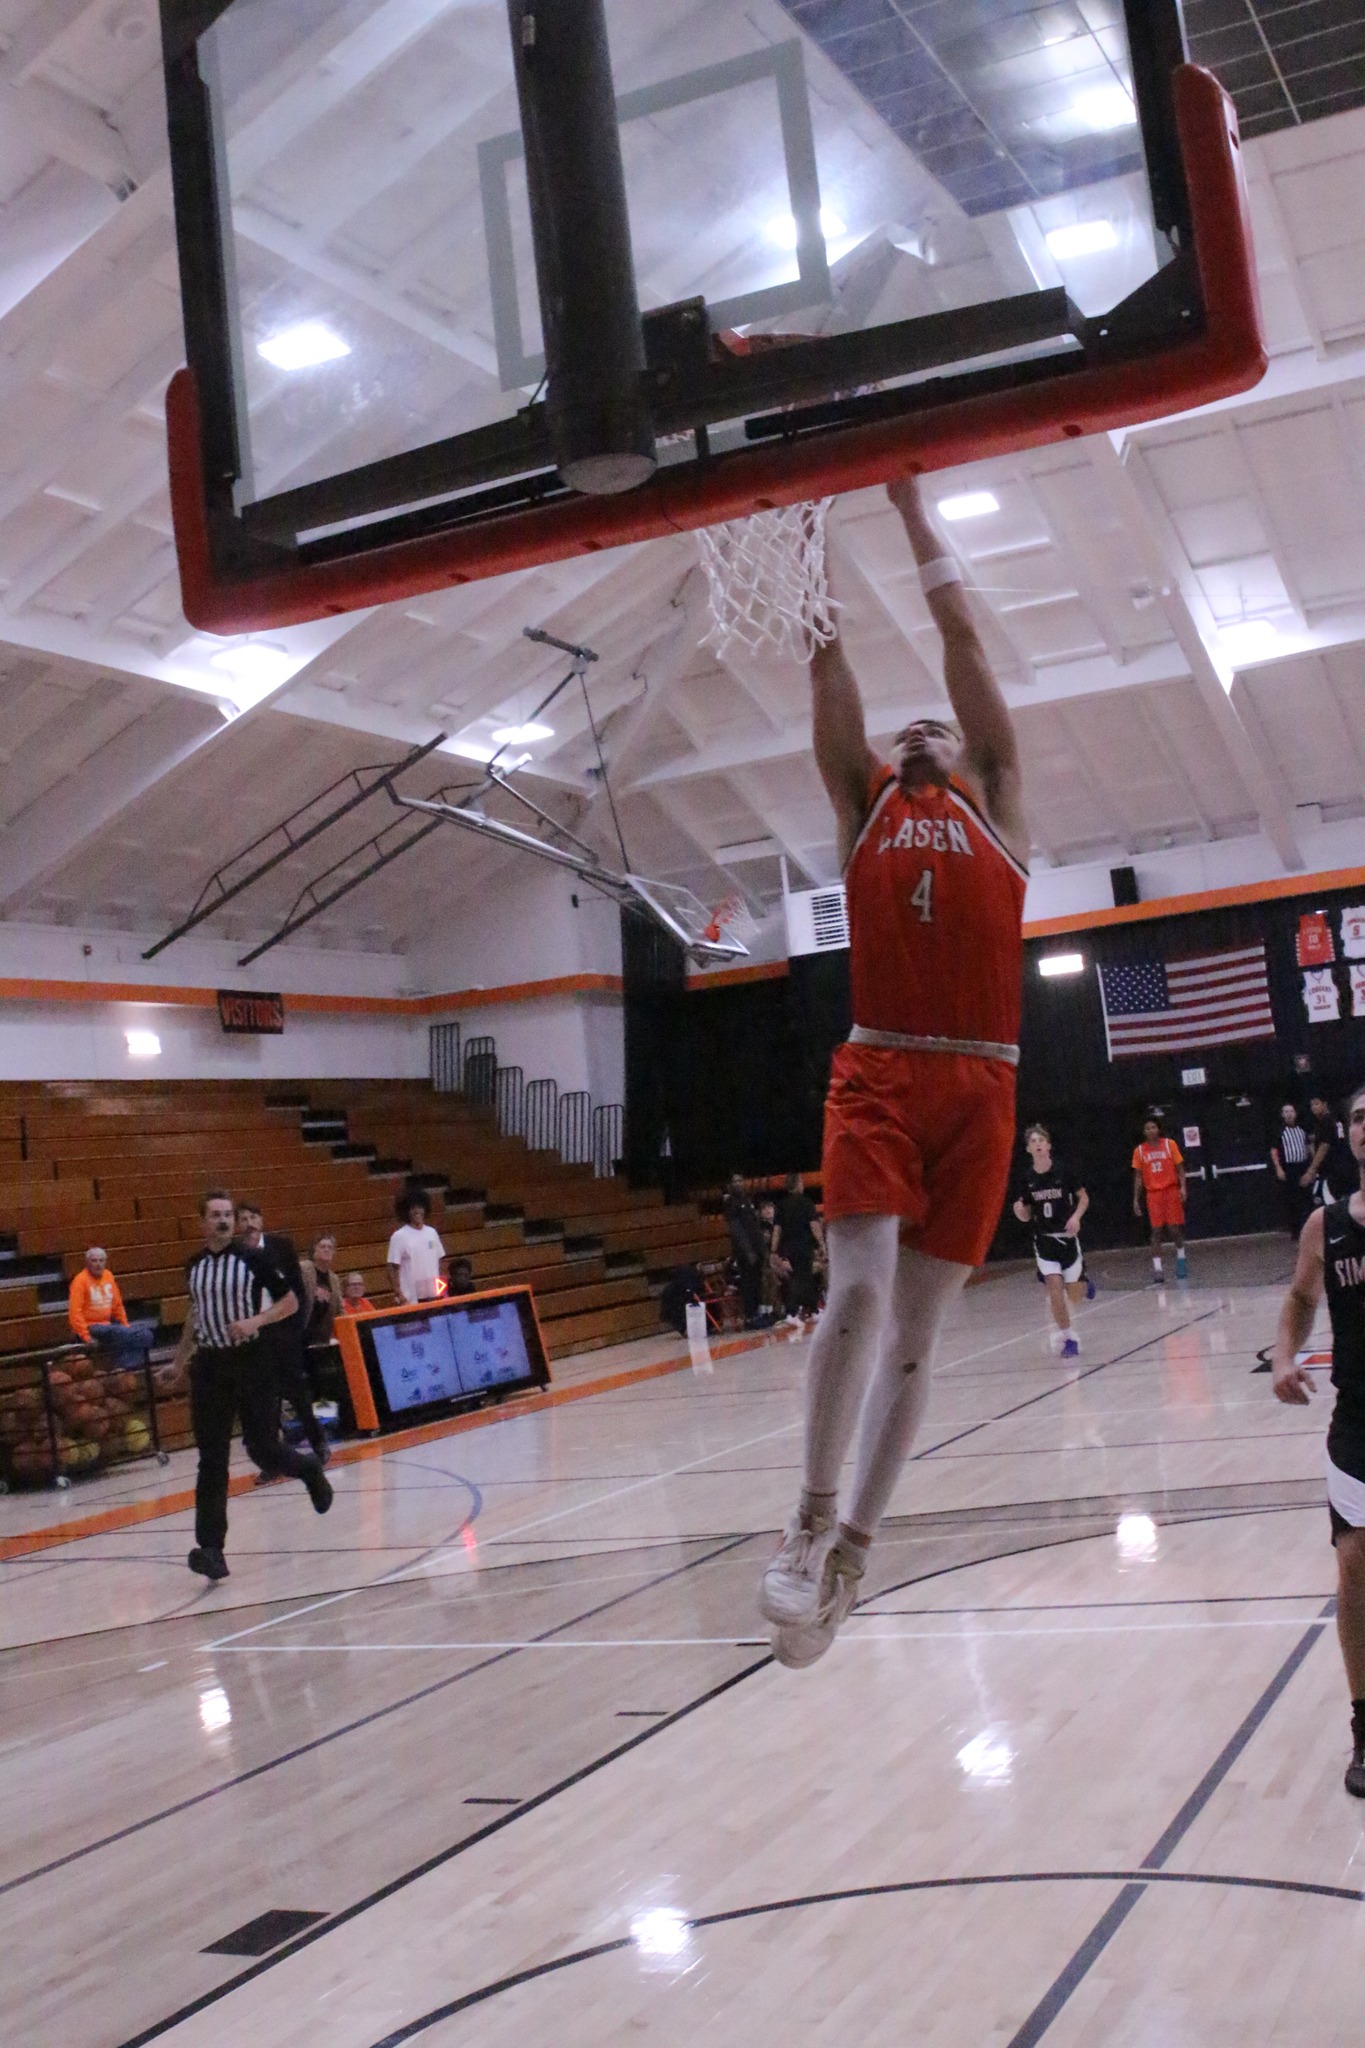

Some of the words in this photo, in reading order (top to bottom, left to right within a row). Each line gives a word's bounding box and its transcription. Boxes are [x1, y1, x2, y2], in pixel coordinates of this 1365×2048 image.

[911, 869, 933, 922] 4
[1150, 1161, 1162, 1173] 32
[1043, 1202, 1053, 1218] 0
